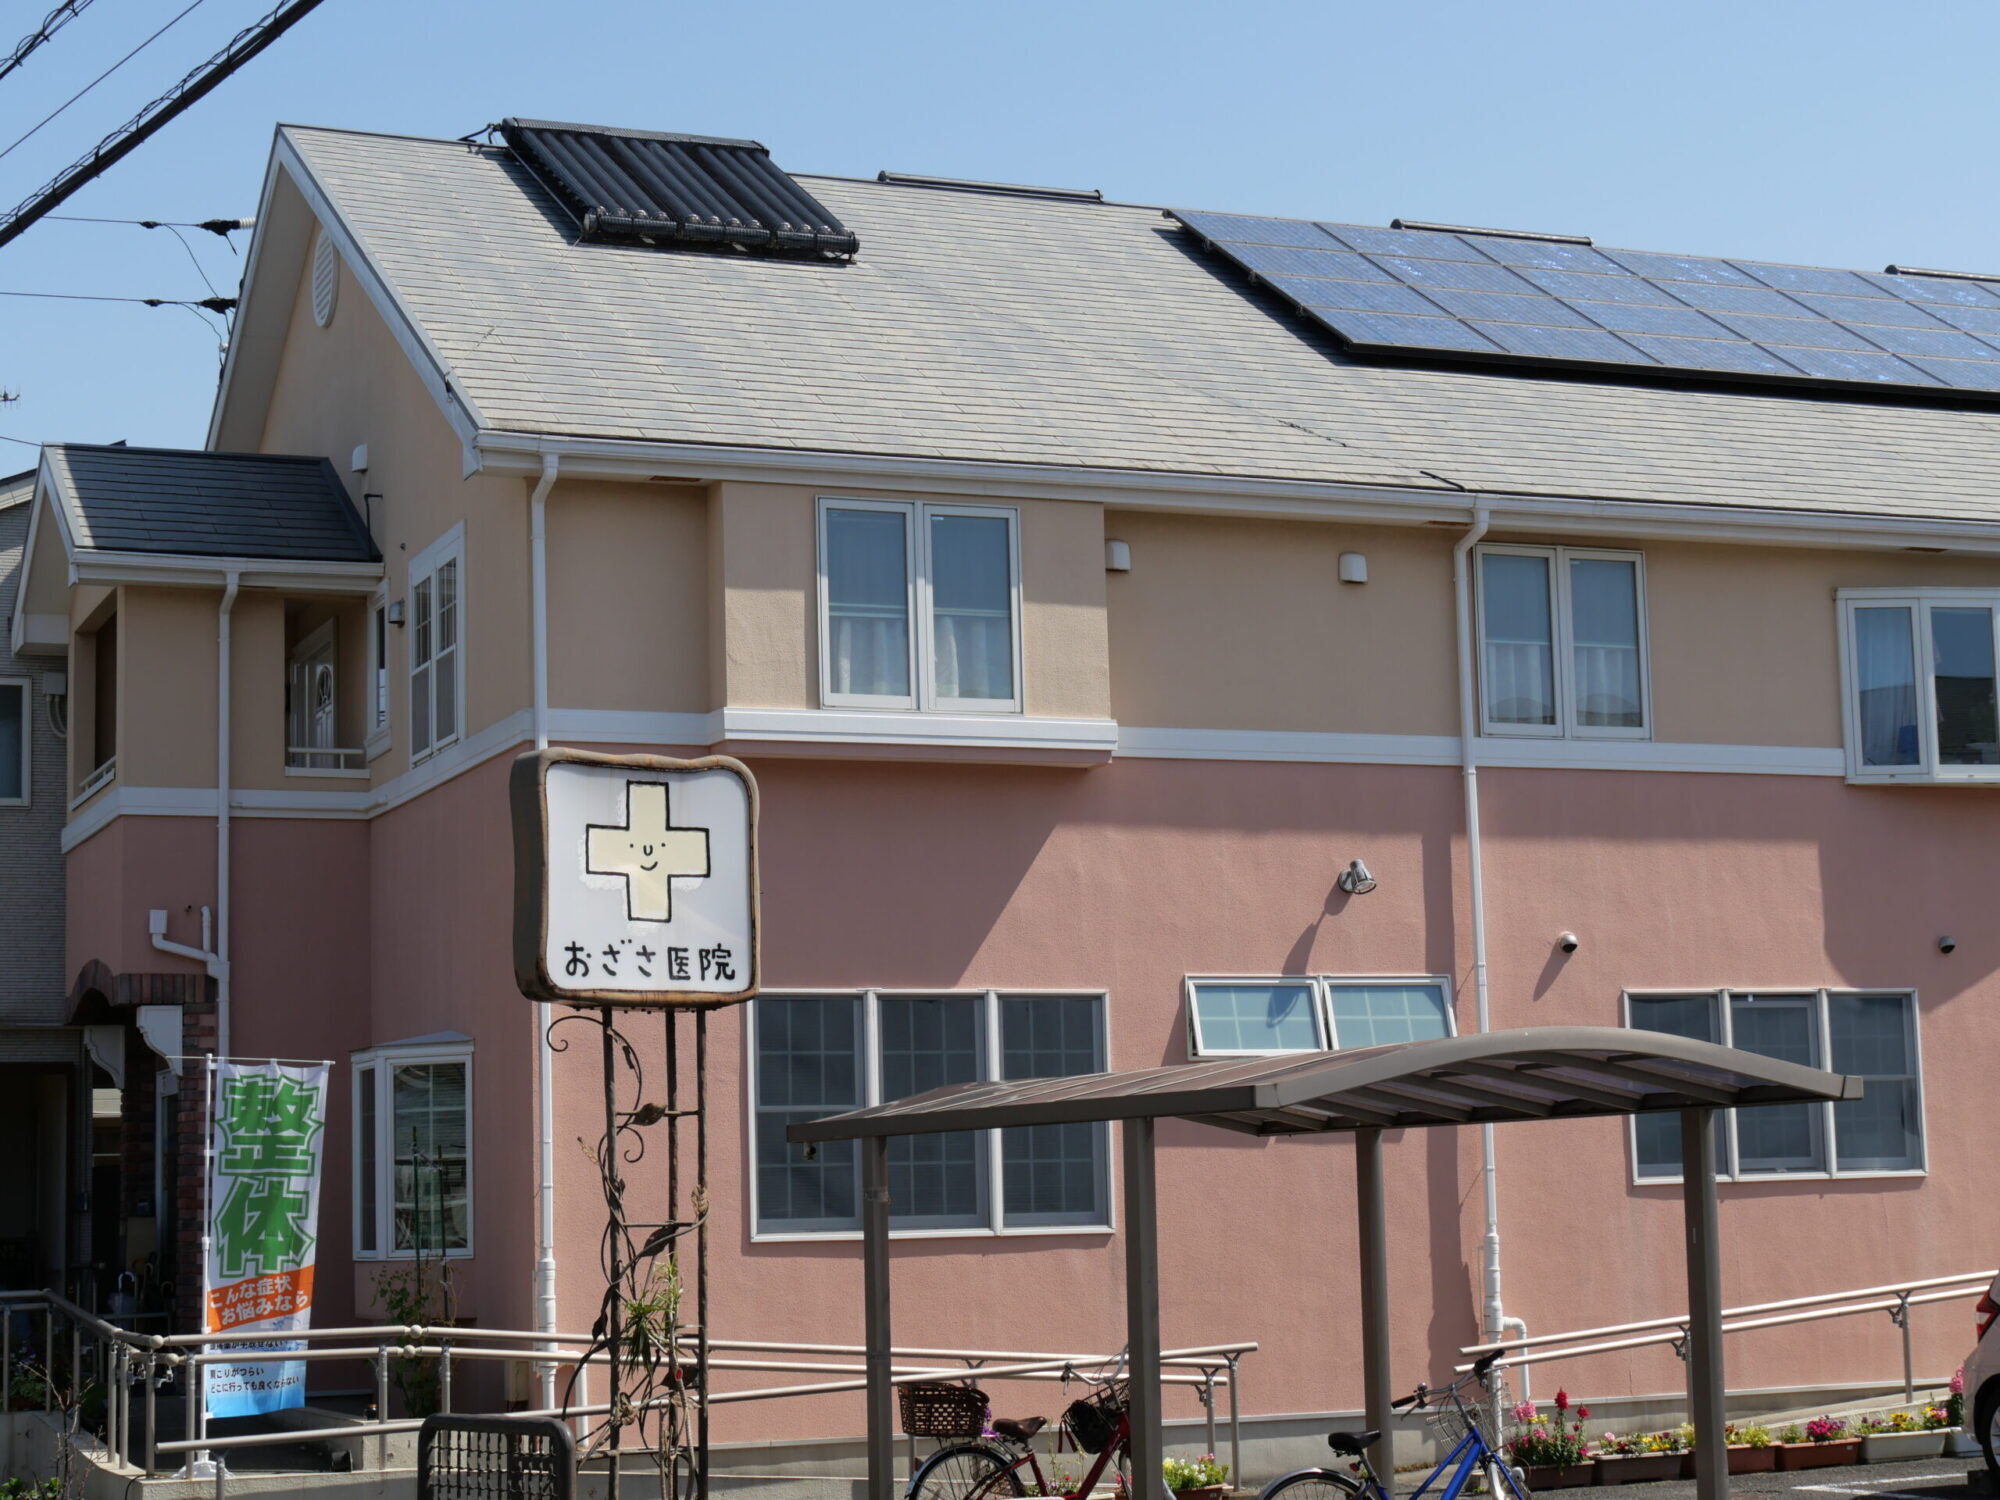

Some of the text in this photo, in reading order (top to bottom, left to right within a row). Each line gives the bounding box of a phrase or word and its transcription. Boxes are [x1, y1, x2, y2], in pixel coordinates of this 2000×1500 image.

[564, 939, 736, 981] おざさ医院
[215, 1074, 324, 1278] 整体
[210, 1275, 292, 1308] こんな症状
[221, 1290, 308, 1325] お悩みなら
